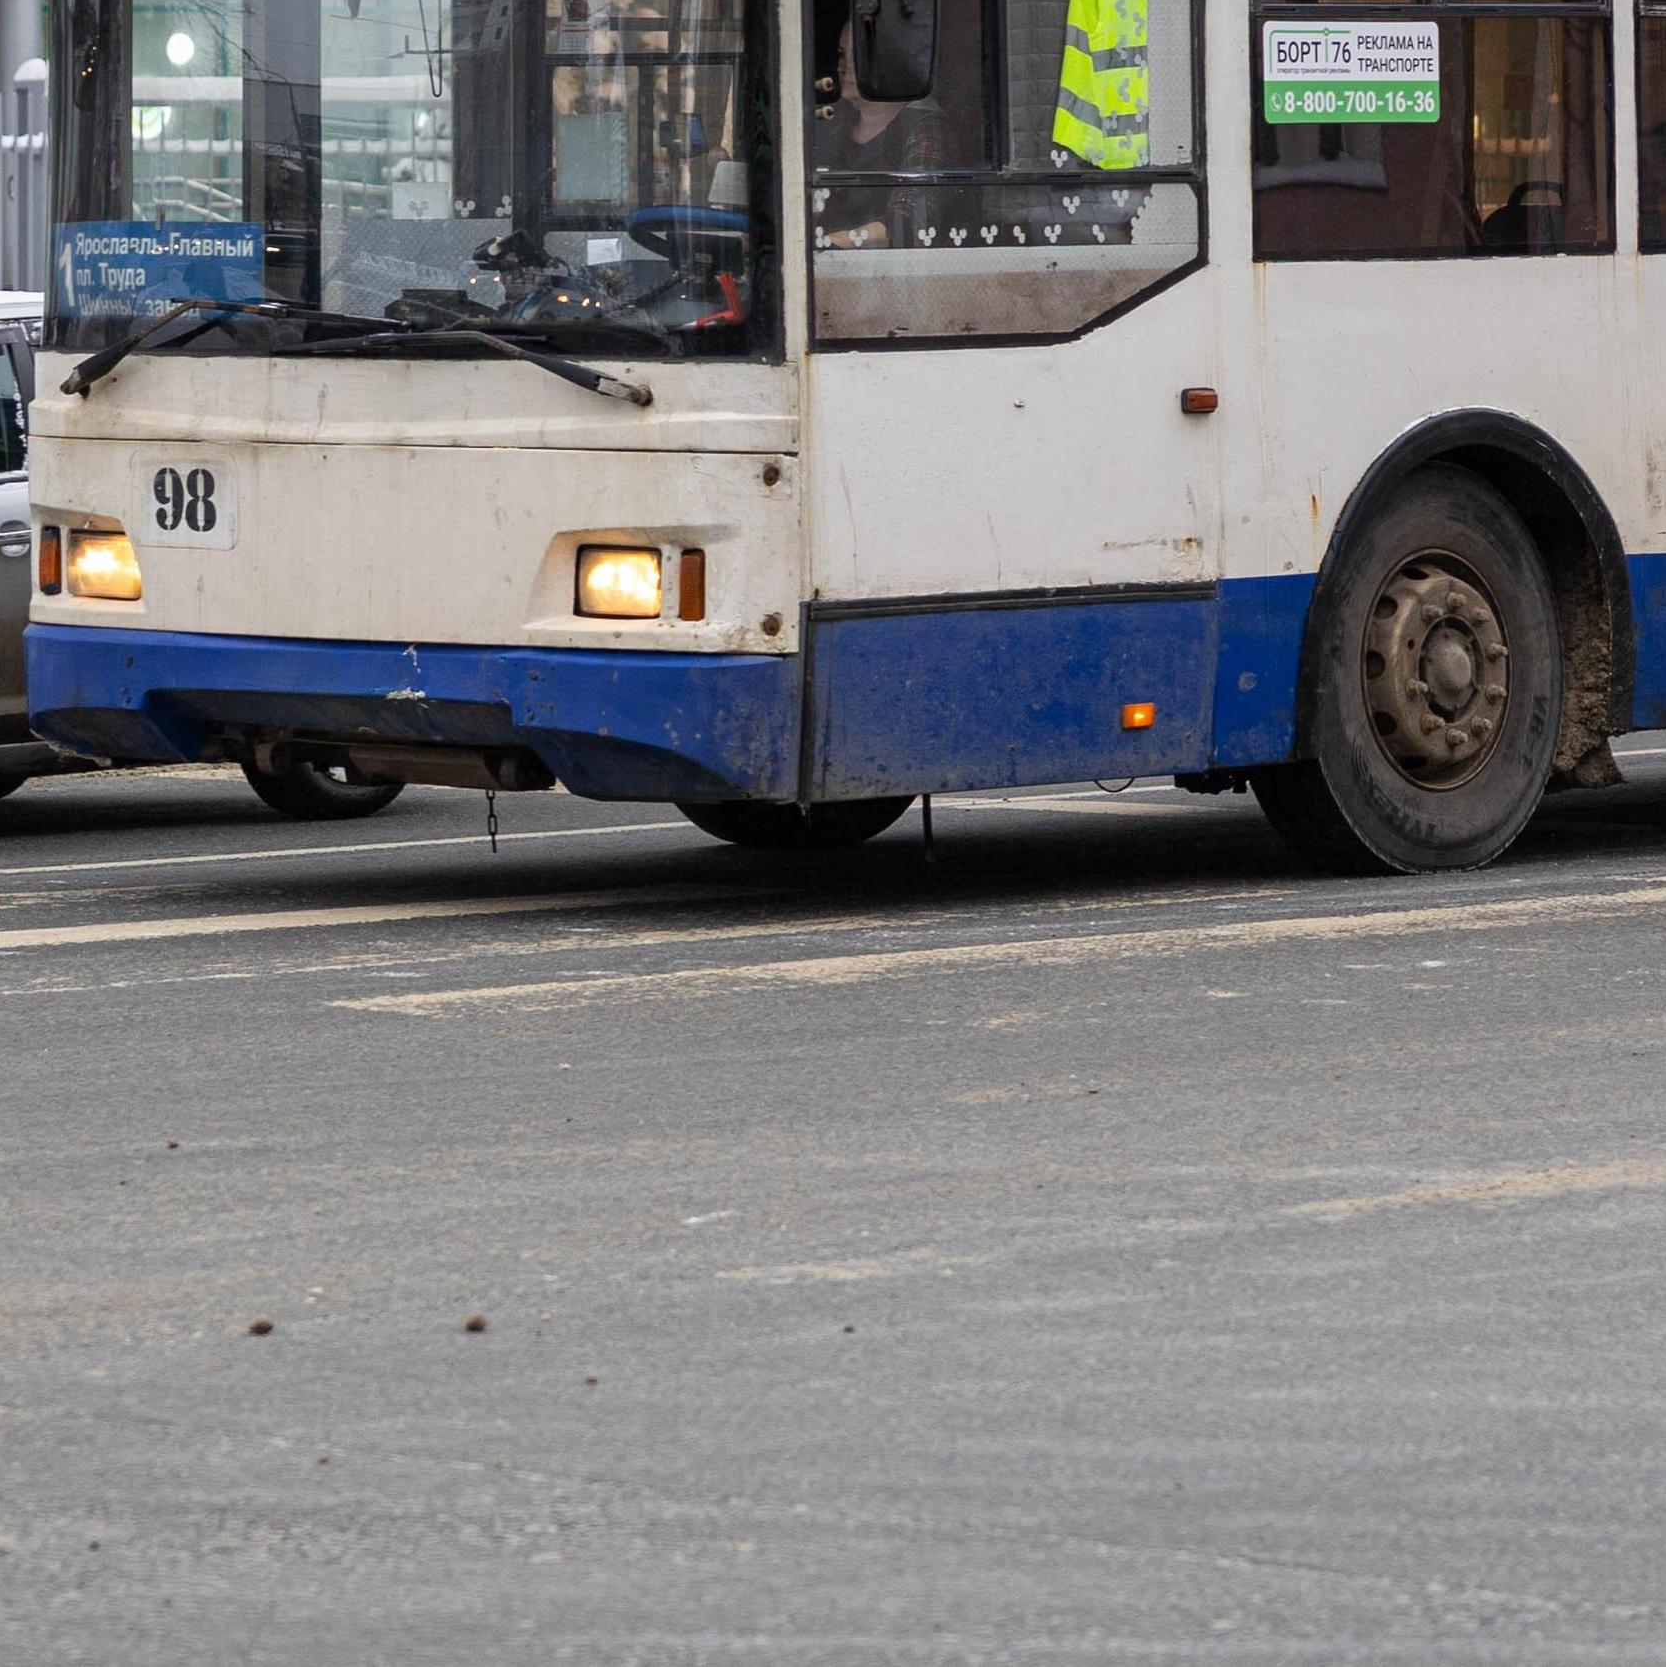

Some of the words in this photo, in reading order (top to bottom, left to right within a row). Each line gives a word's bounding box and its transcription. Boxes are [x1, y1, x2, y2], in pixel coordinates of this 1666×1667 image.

[1276, 41, 1321, 63] БОРТ
[1332, 41, 1352, 63] 76
[1357, 35, 1413, 50] РЕКЛАМА
[1417, 35, 1434, 50] НА
[1358, 57, 1434, 73] ТРАНСПОРТЕ
[1284, 91, 1435, 113] 8-800-700-16-36
[58, 242, 75, 308] 1
[98, 262, 146, 292] Труда
[153, 467, 217, 532] 98
